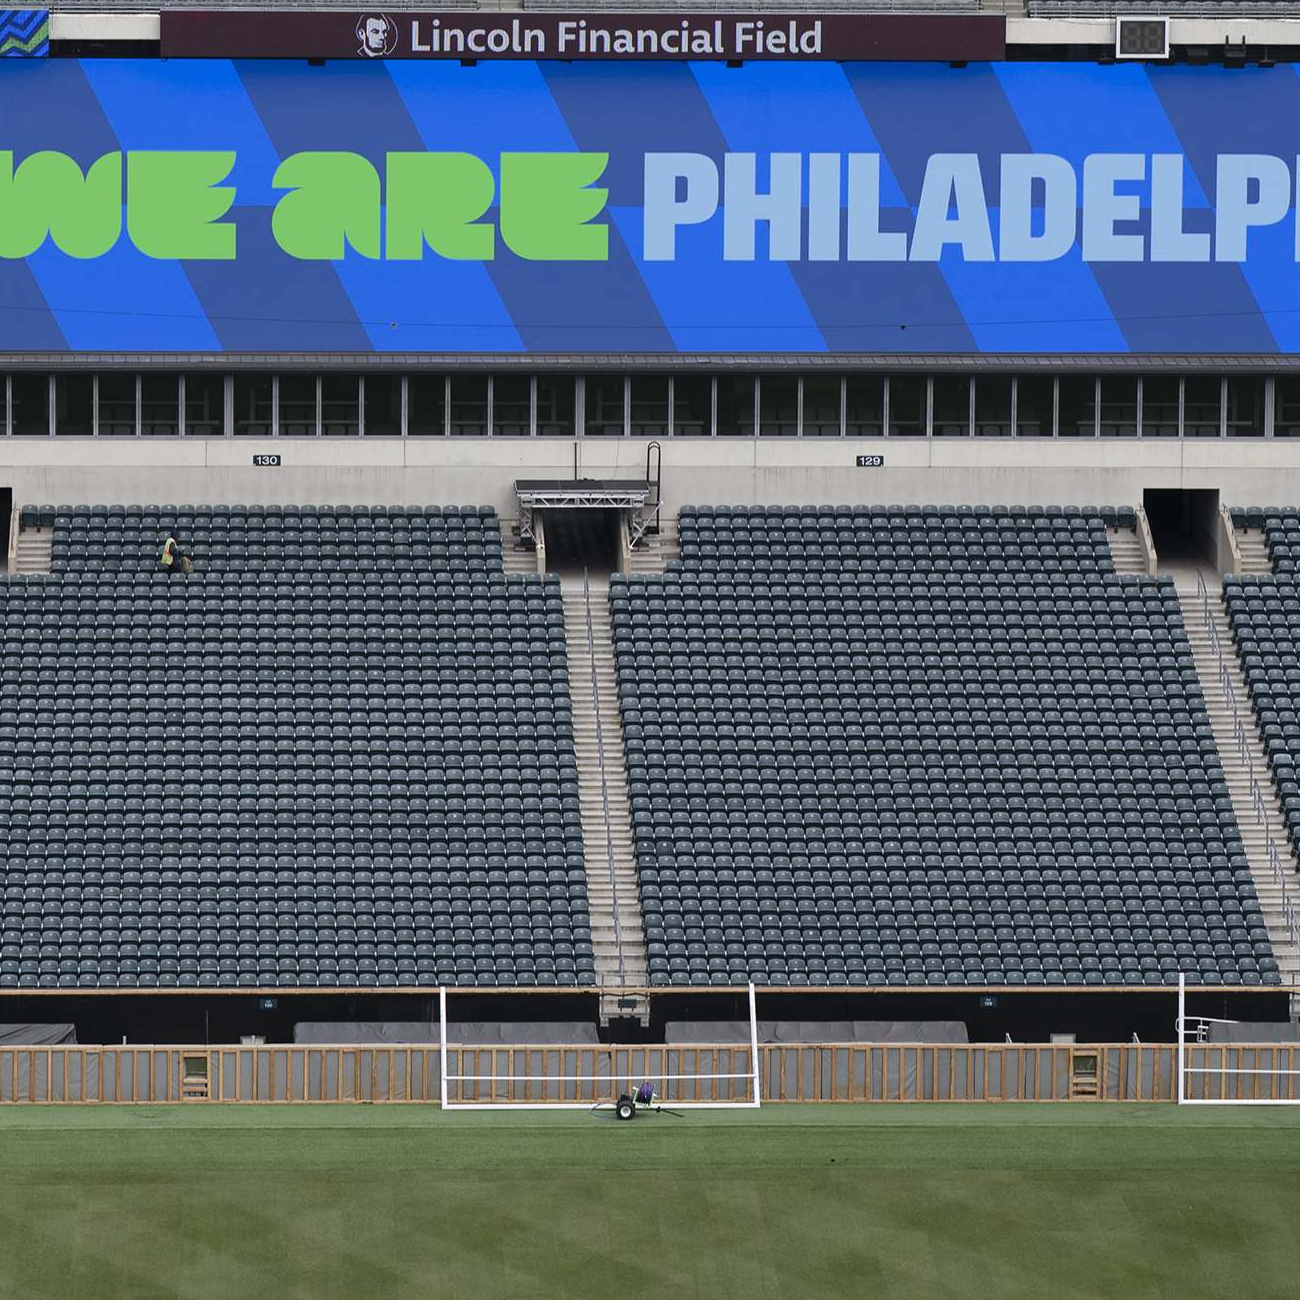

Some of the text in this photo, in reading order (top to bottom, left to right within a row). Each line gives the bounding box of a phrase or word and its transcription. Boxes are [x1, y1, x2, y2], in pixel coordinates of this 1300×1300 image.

[411, 19, 822, 54] Lincoln Financial Field
[272, 152, 609, 261] ARE
[256, 456, 278, 465] 130
[860, 456, 880, 466] 129
